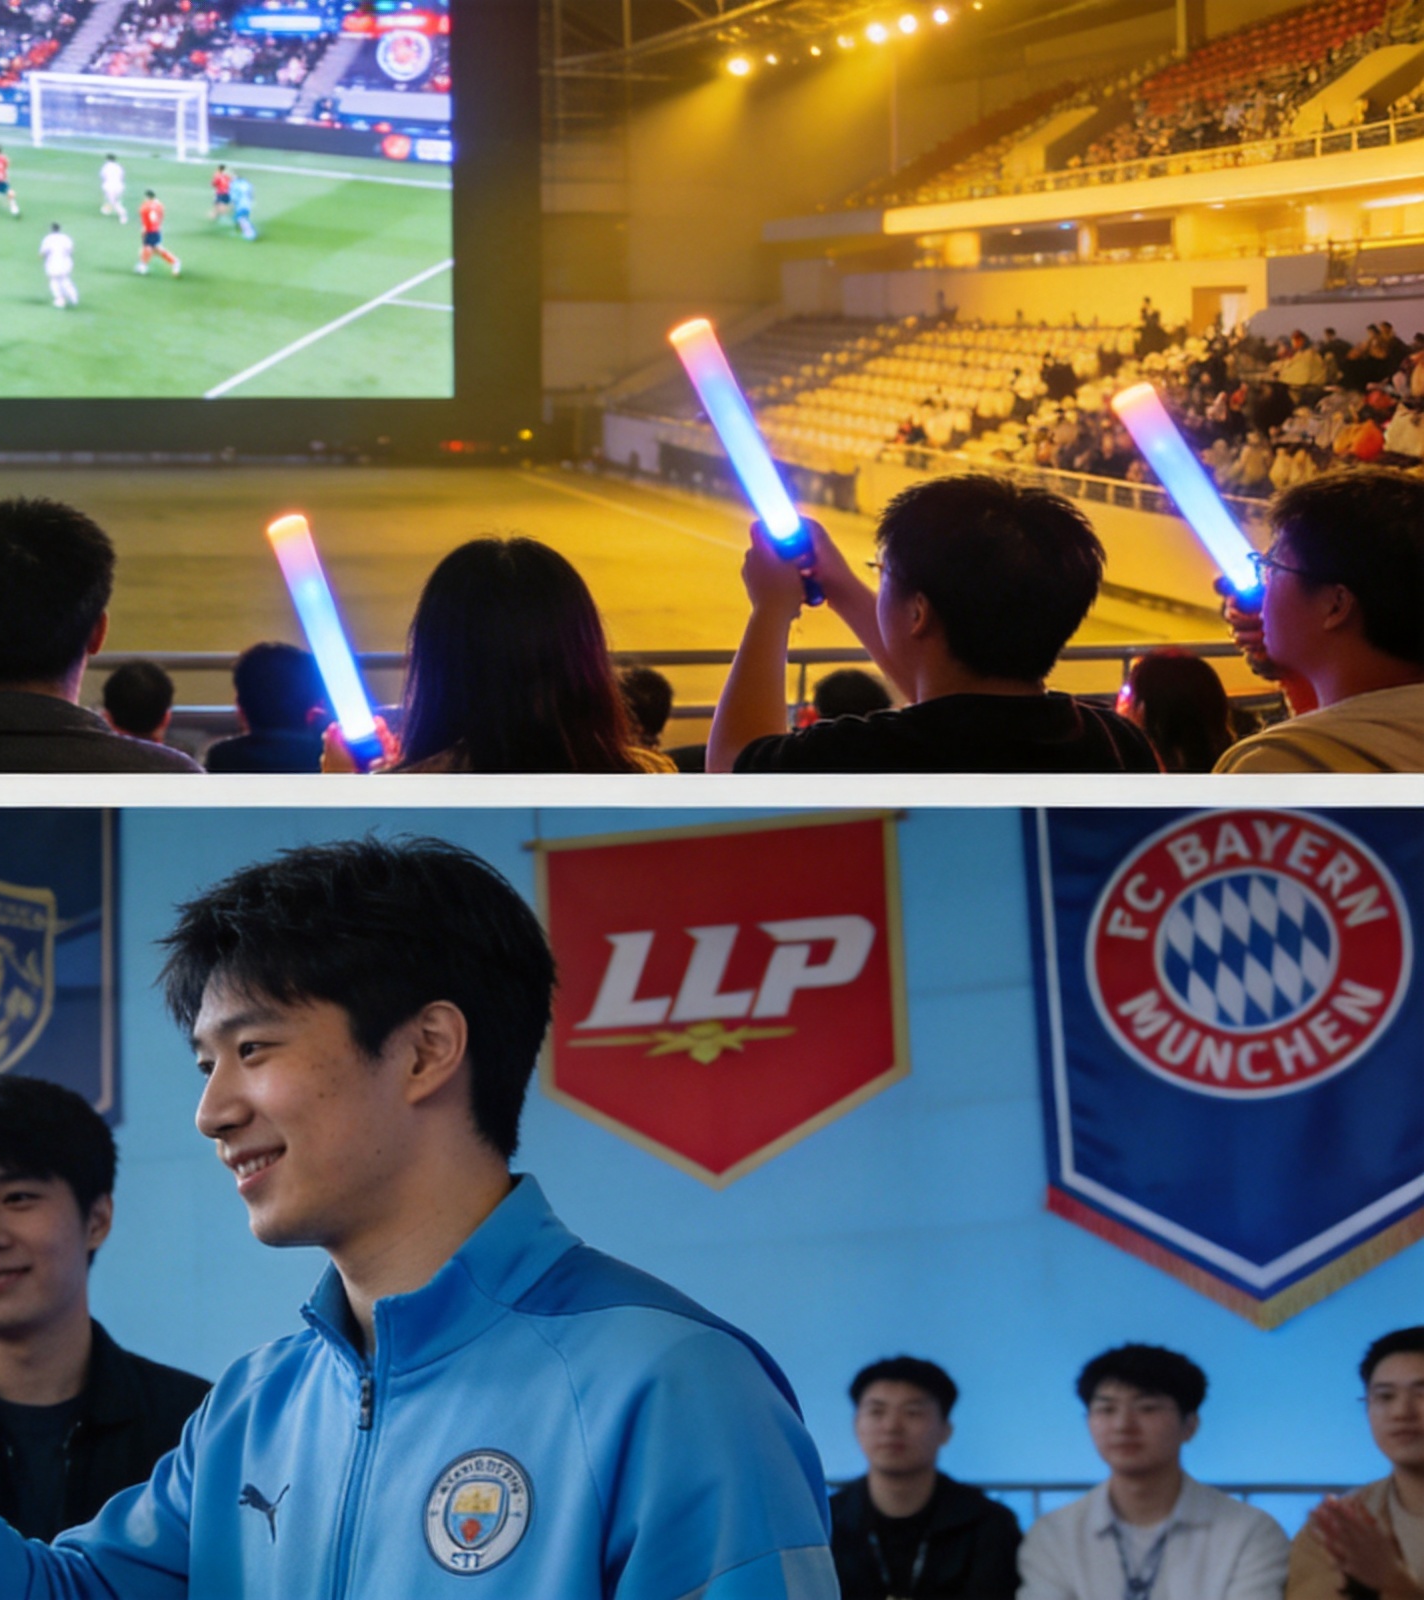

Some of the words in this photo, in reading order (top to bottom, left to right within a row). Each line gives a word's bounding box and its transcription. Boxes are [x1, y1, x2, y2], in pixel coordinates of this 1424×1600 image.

[1106, 873, 1165, 941] FC
[1166, 819, 1389, 928] BAYERN
[572, 914, 876, 1030] LLP
[1117, 979, 1384, 1083] MUNCHEN
